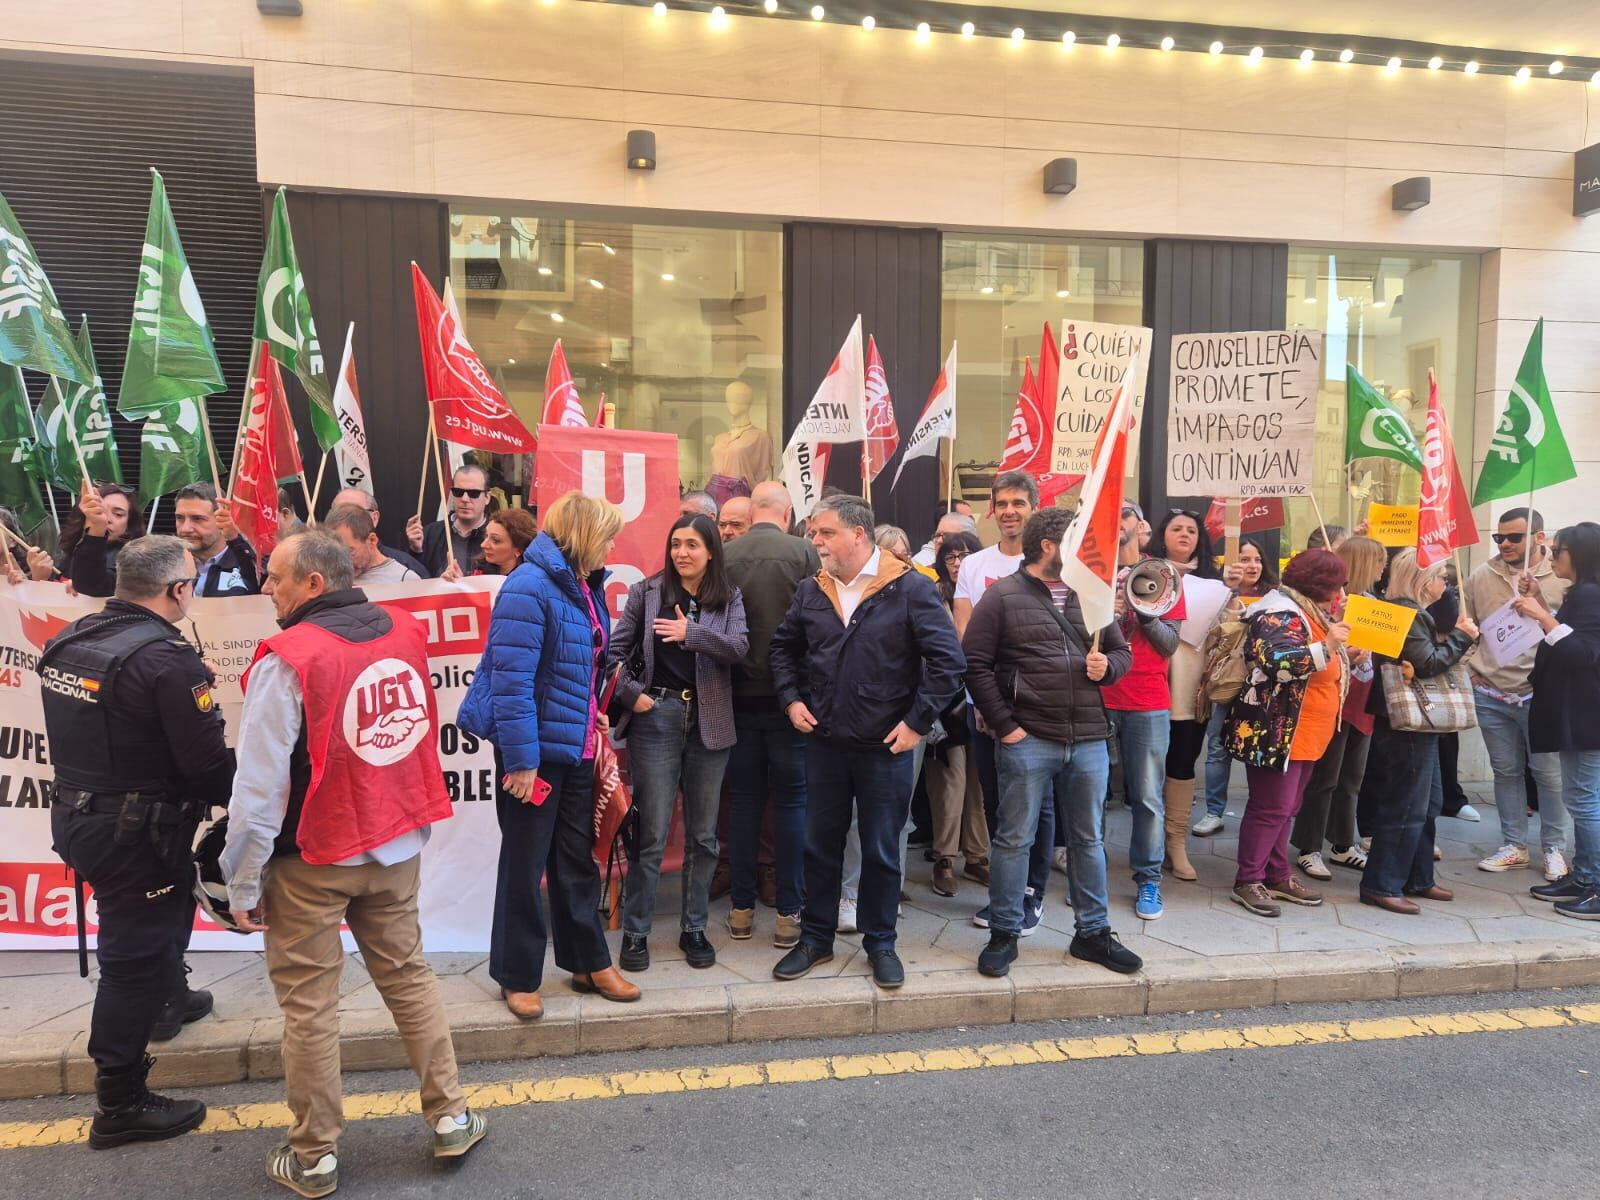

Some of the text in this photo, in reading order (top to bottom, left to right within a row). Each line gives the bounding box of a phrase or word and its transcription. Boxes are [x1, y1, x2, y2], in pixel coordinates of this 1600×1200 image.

[1061, 385, 1074, 402] A
[1084, 386, 1113, 403] LOS
[1175, 370, 1307, 410] PROMETE,
[1258, 485, 1285, 495] SANTA
[1289, 486, 1305, 495] FAZ
[41, 679, 98, 704] NACIONAL
[357, 669, 419, 730] UGT
